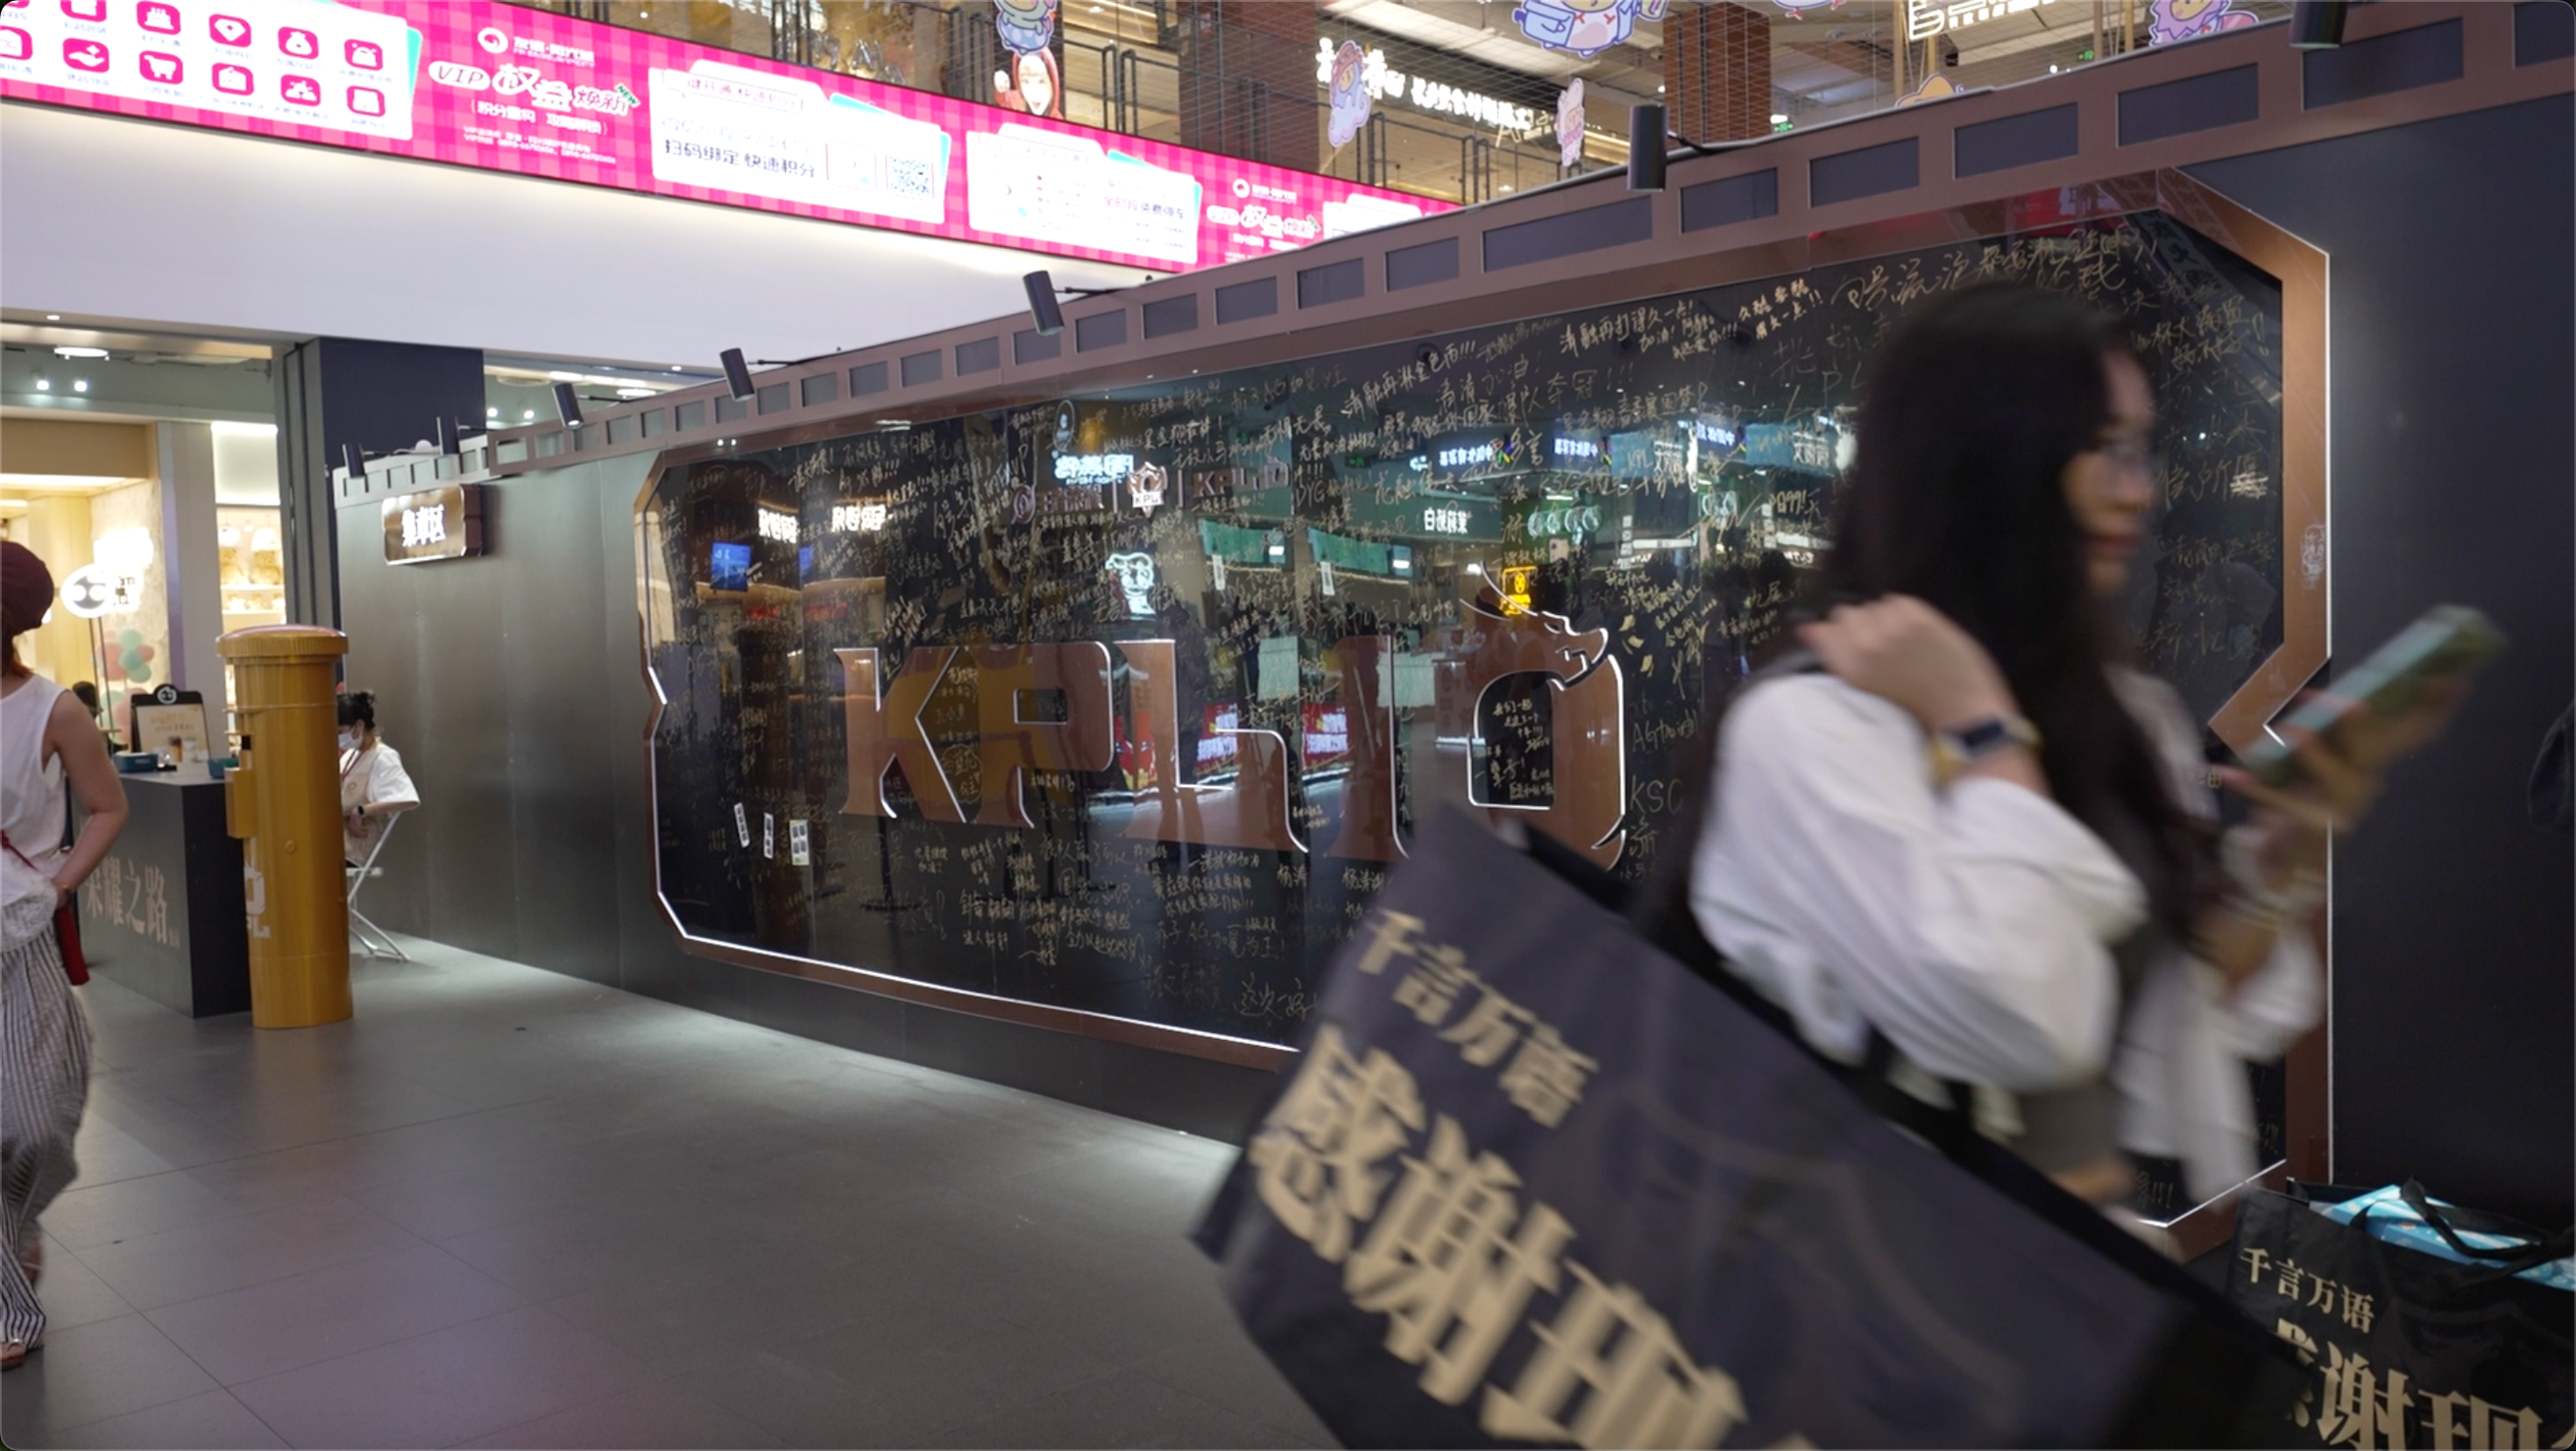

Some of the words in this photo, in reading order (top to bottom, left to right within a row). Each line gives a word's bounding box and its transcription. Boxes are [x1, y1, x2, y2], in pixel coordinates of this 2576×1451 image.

[437, 64, 485, 84] VIP
[664, 138, 740, 166] 扫码绑定
[744, 153, 815, 178] 快速积分
[1358, 908, 1601, 1130] 千言万语
[2240, 1247, 2375, 1334] 千言万语
